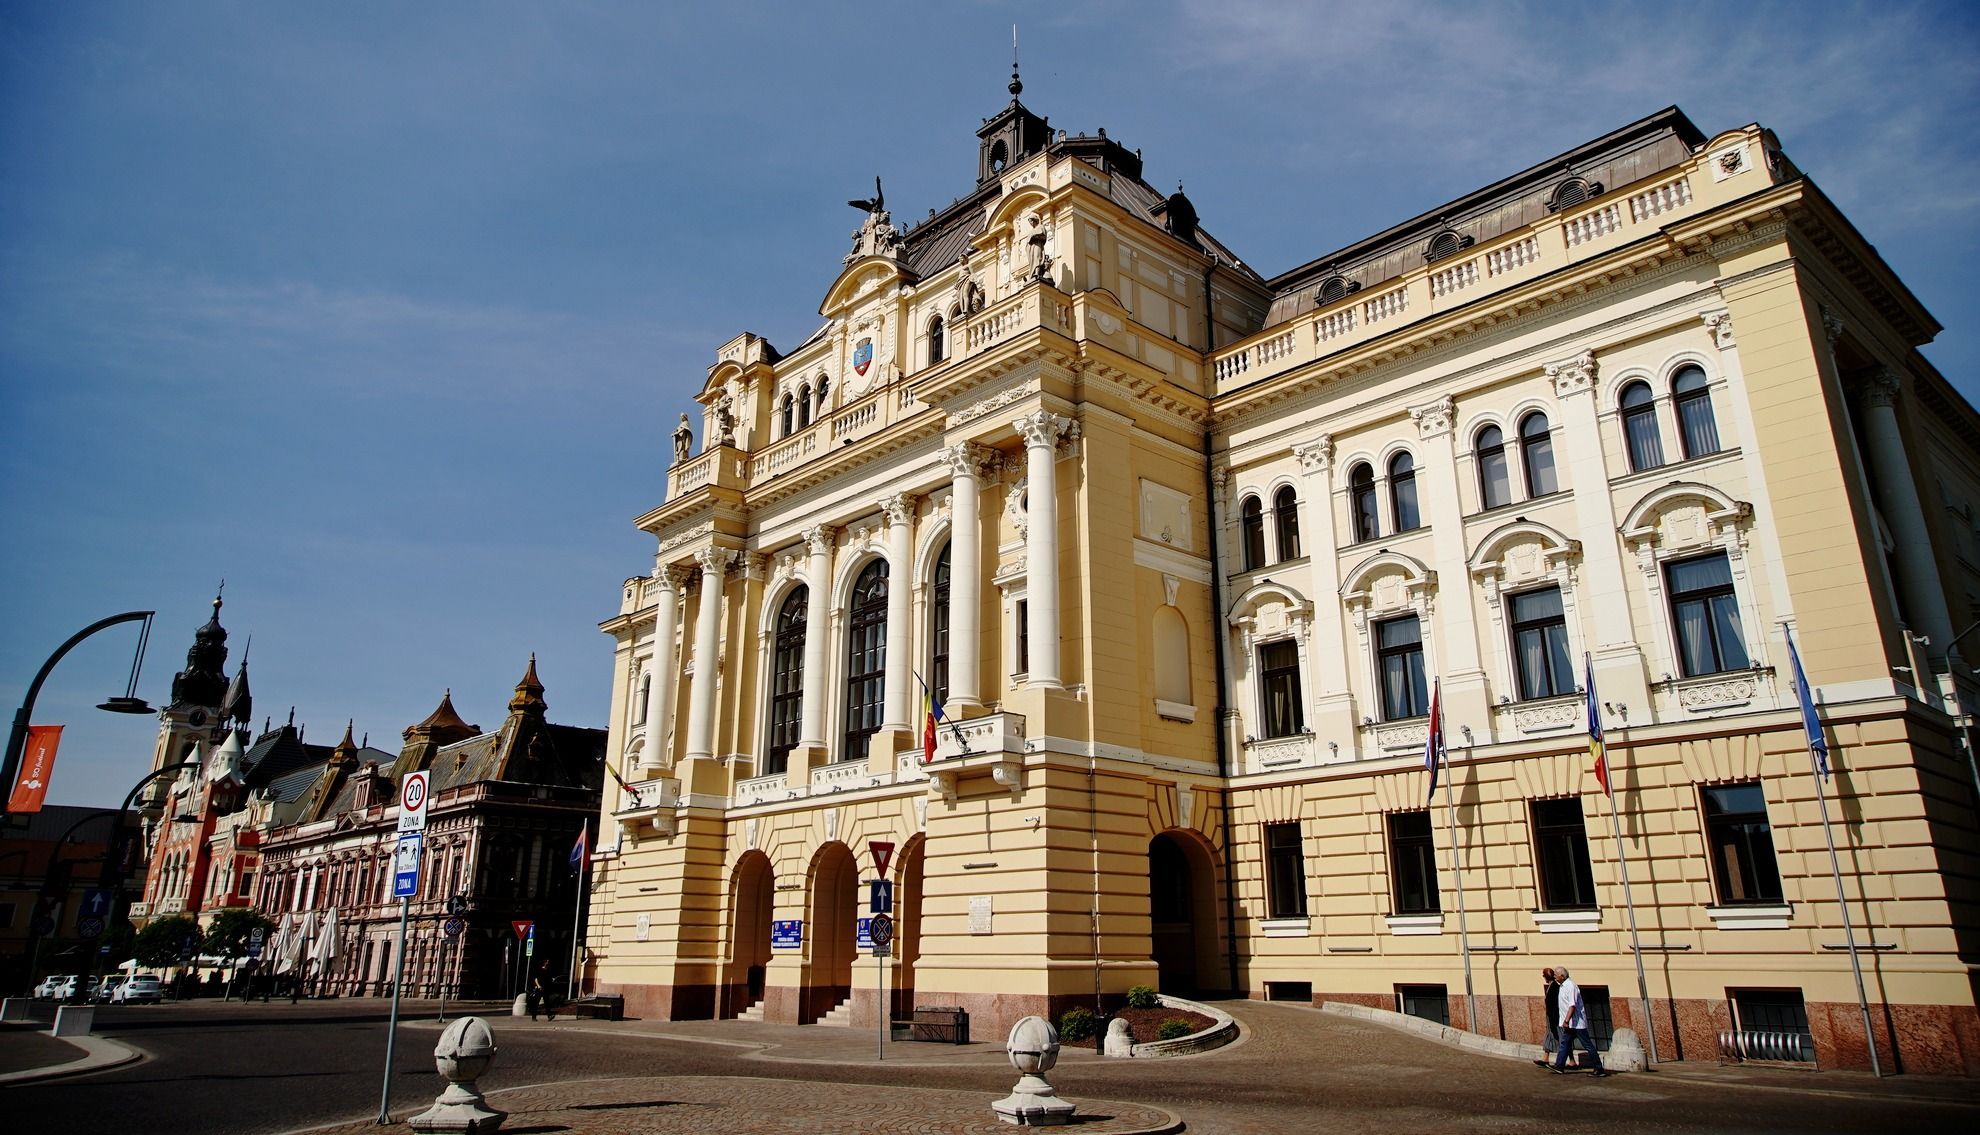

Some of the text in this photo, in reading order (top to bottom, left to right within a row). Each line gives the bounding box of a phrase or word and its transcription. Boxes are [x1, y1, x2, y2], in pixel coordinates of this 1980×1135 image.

[408, 783, 422, 802] 20
[403, 815, 419, 828] ZONA
[397, 877, 411, 890] ZONA
